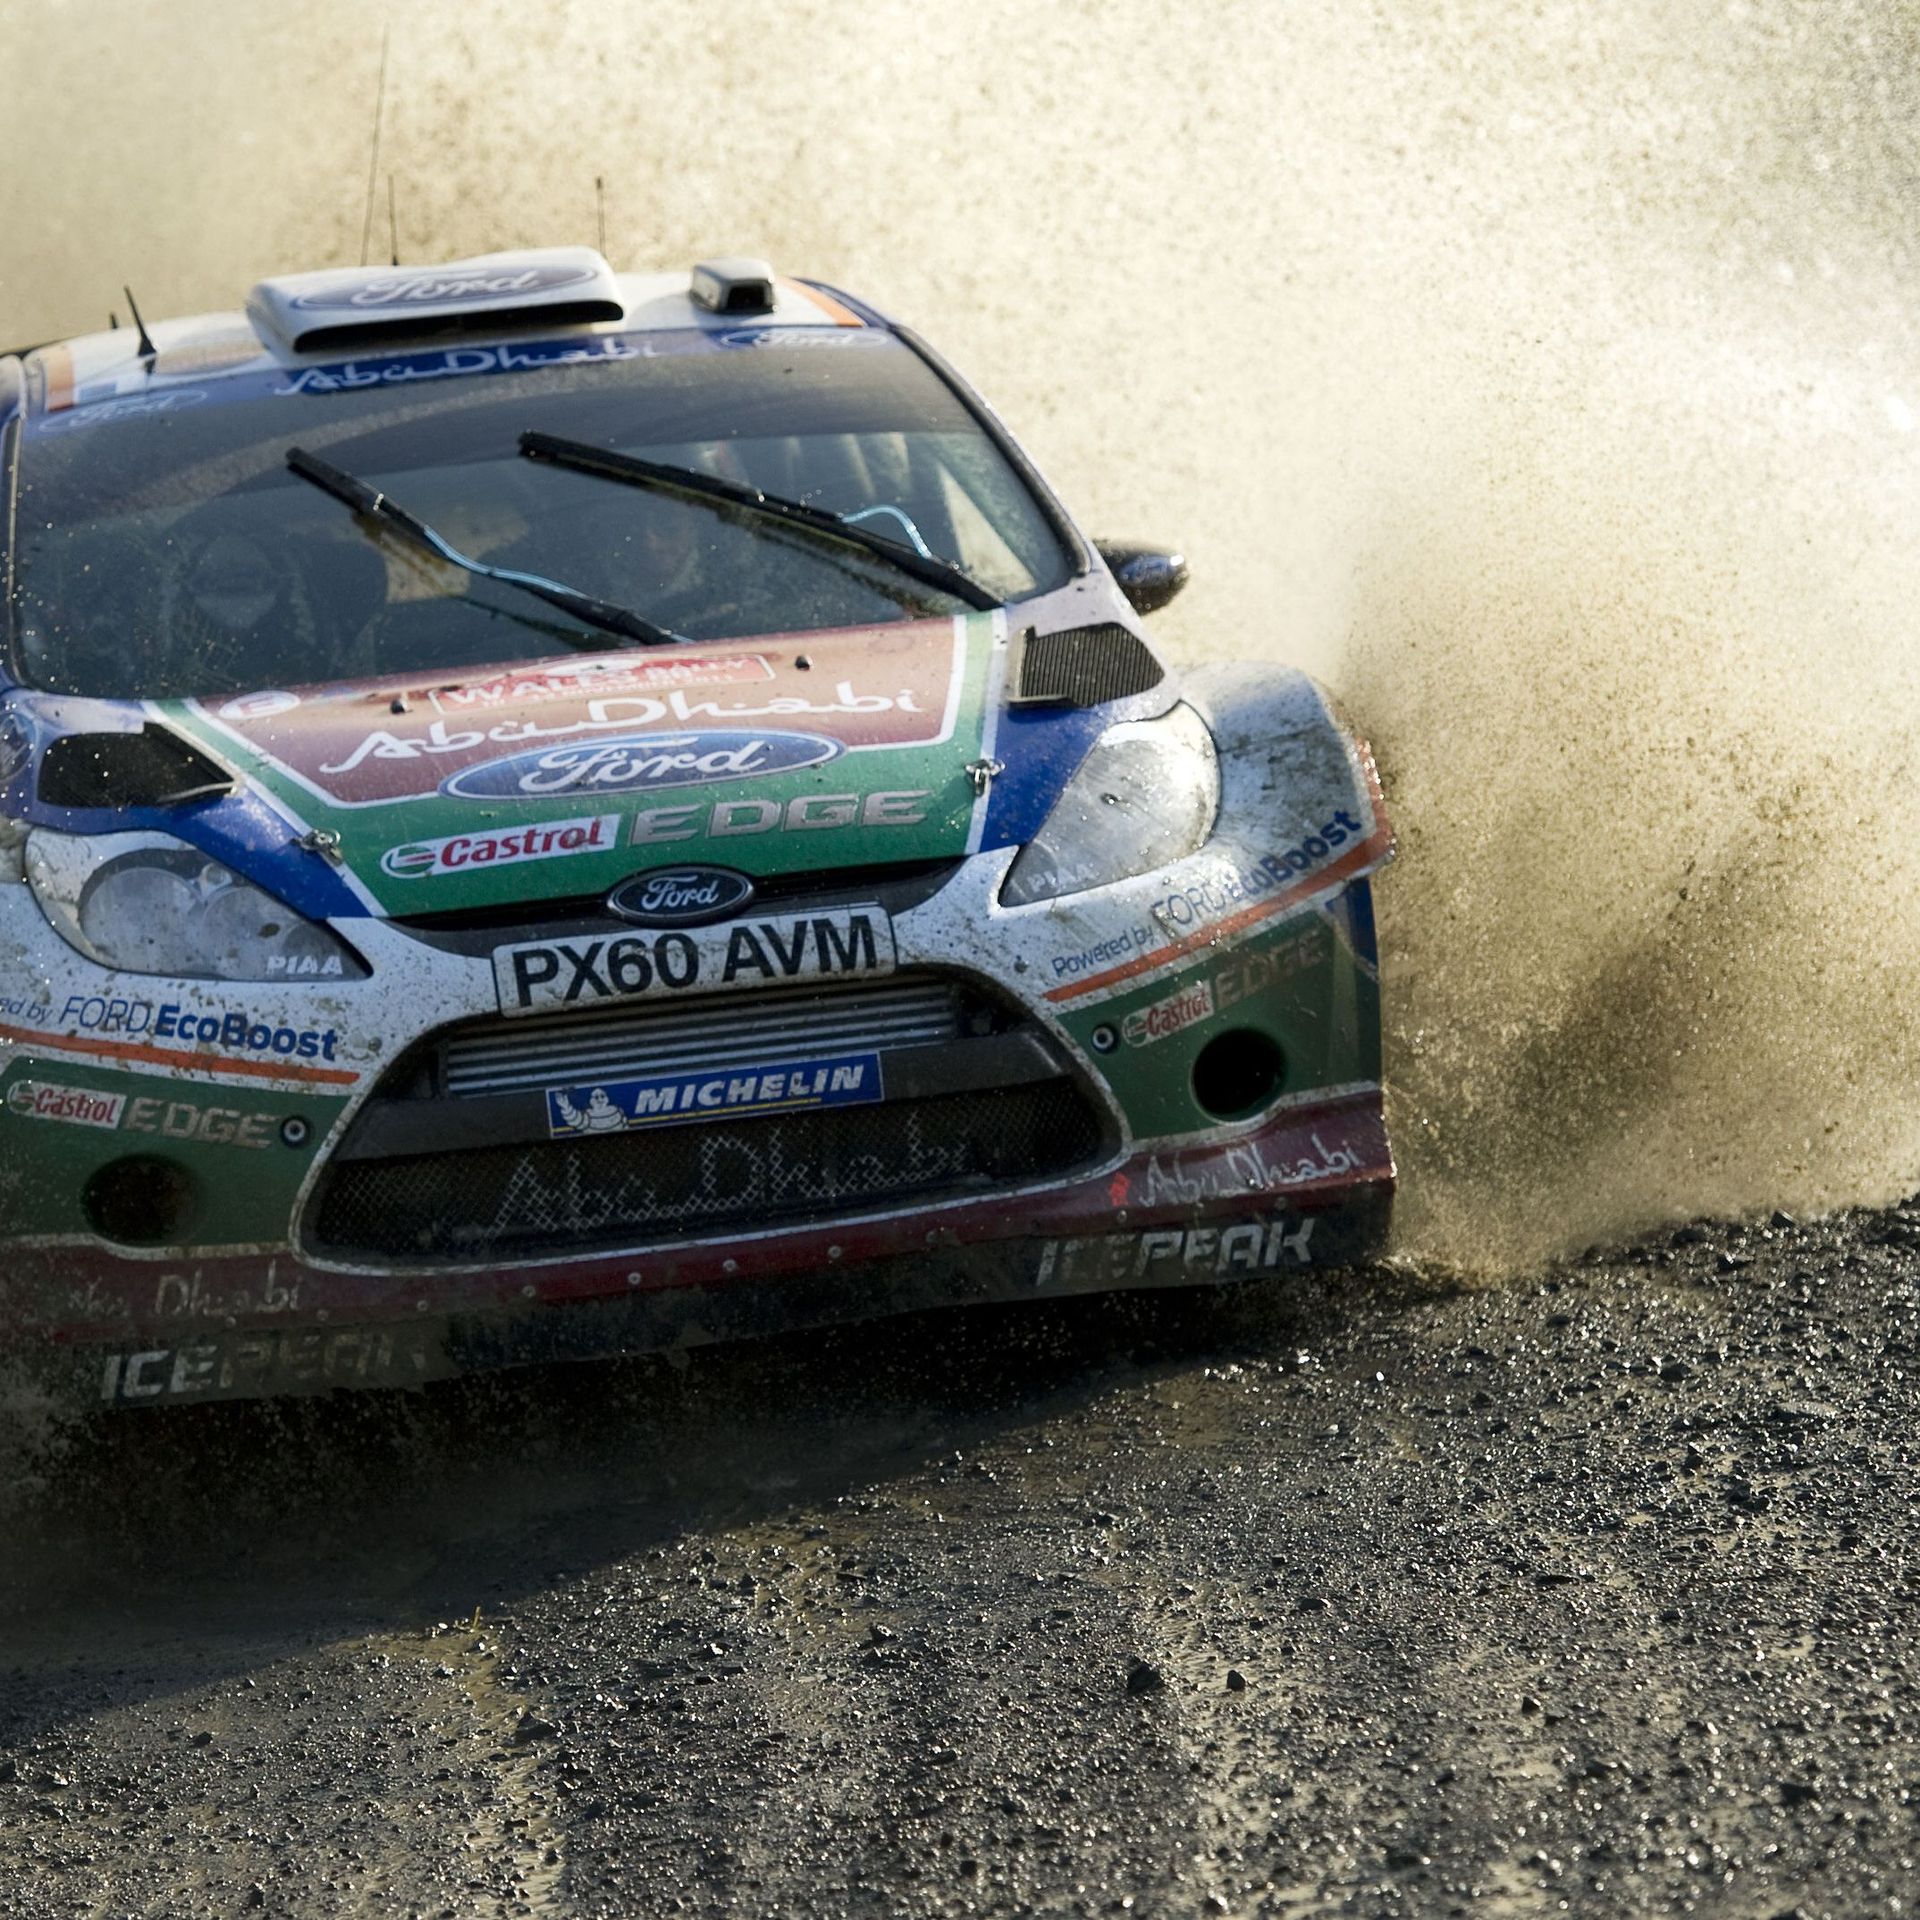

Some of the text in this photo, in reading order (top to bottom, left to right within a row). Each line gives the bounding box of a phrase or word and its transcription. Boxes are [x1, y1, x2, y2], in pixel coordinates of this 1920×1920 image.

[352, 268, 541, 307] Ford
[518, 737, 767, 793] Ford
[441, 790, 930, 867] Castrol EDGE
[642, 874, 719, 911] Ford
[265, 955, 344, 975] PIAA
[512, 914, 878, 1007] PX60 AVM
[1050, 931, 1133, 978] Powered
[27, 1001, 51, 1024] by
[1149, 989, 1210, 1034] Castrol
[634, 1064, 864, 1115] MICHELIN
[35, 1087, 278, 1150] Castrol EDGE
